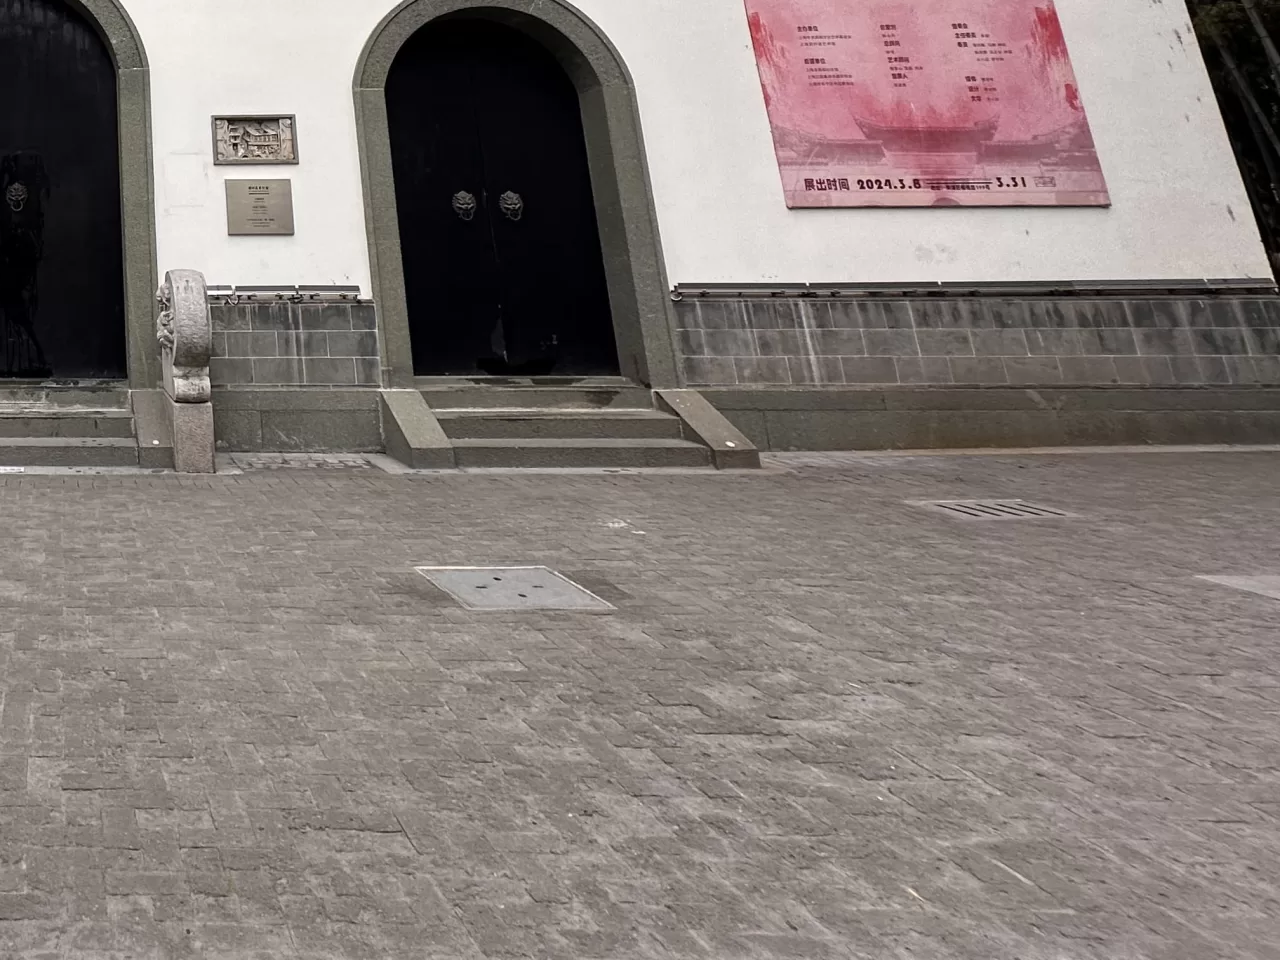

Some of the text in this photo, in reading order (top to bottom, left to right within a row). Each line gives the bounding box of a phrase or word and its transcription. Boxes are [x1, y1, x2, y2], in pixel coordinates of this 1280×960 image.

[804, 178, 850, 190] 展出时间
[857, 179, 922, 190] 2024.3.8
[996, 177, 1027, 188] 3.31
